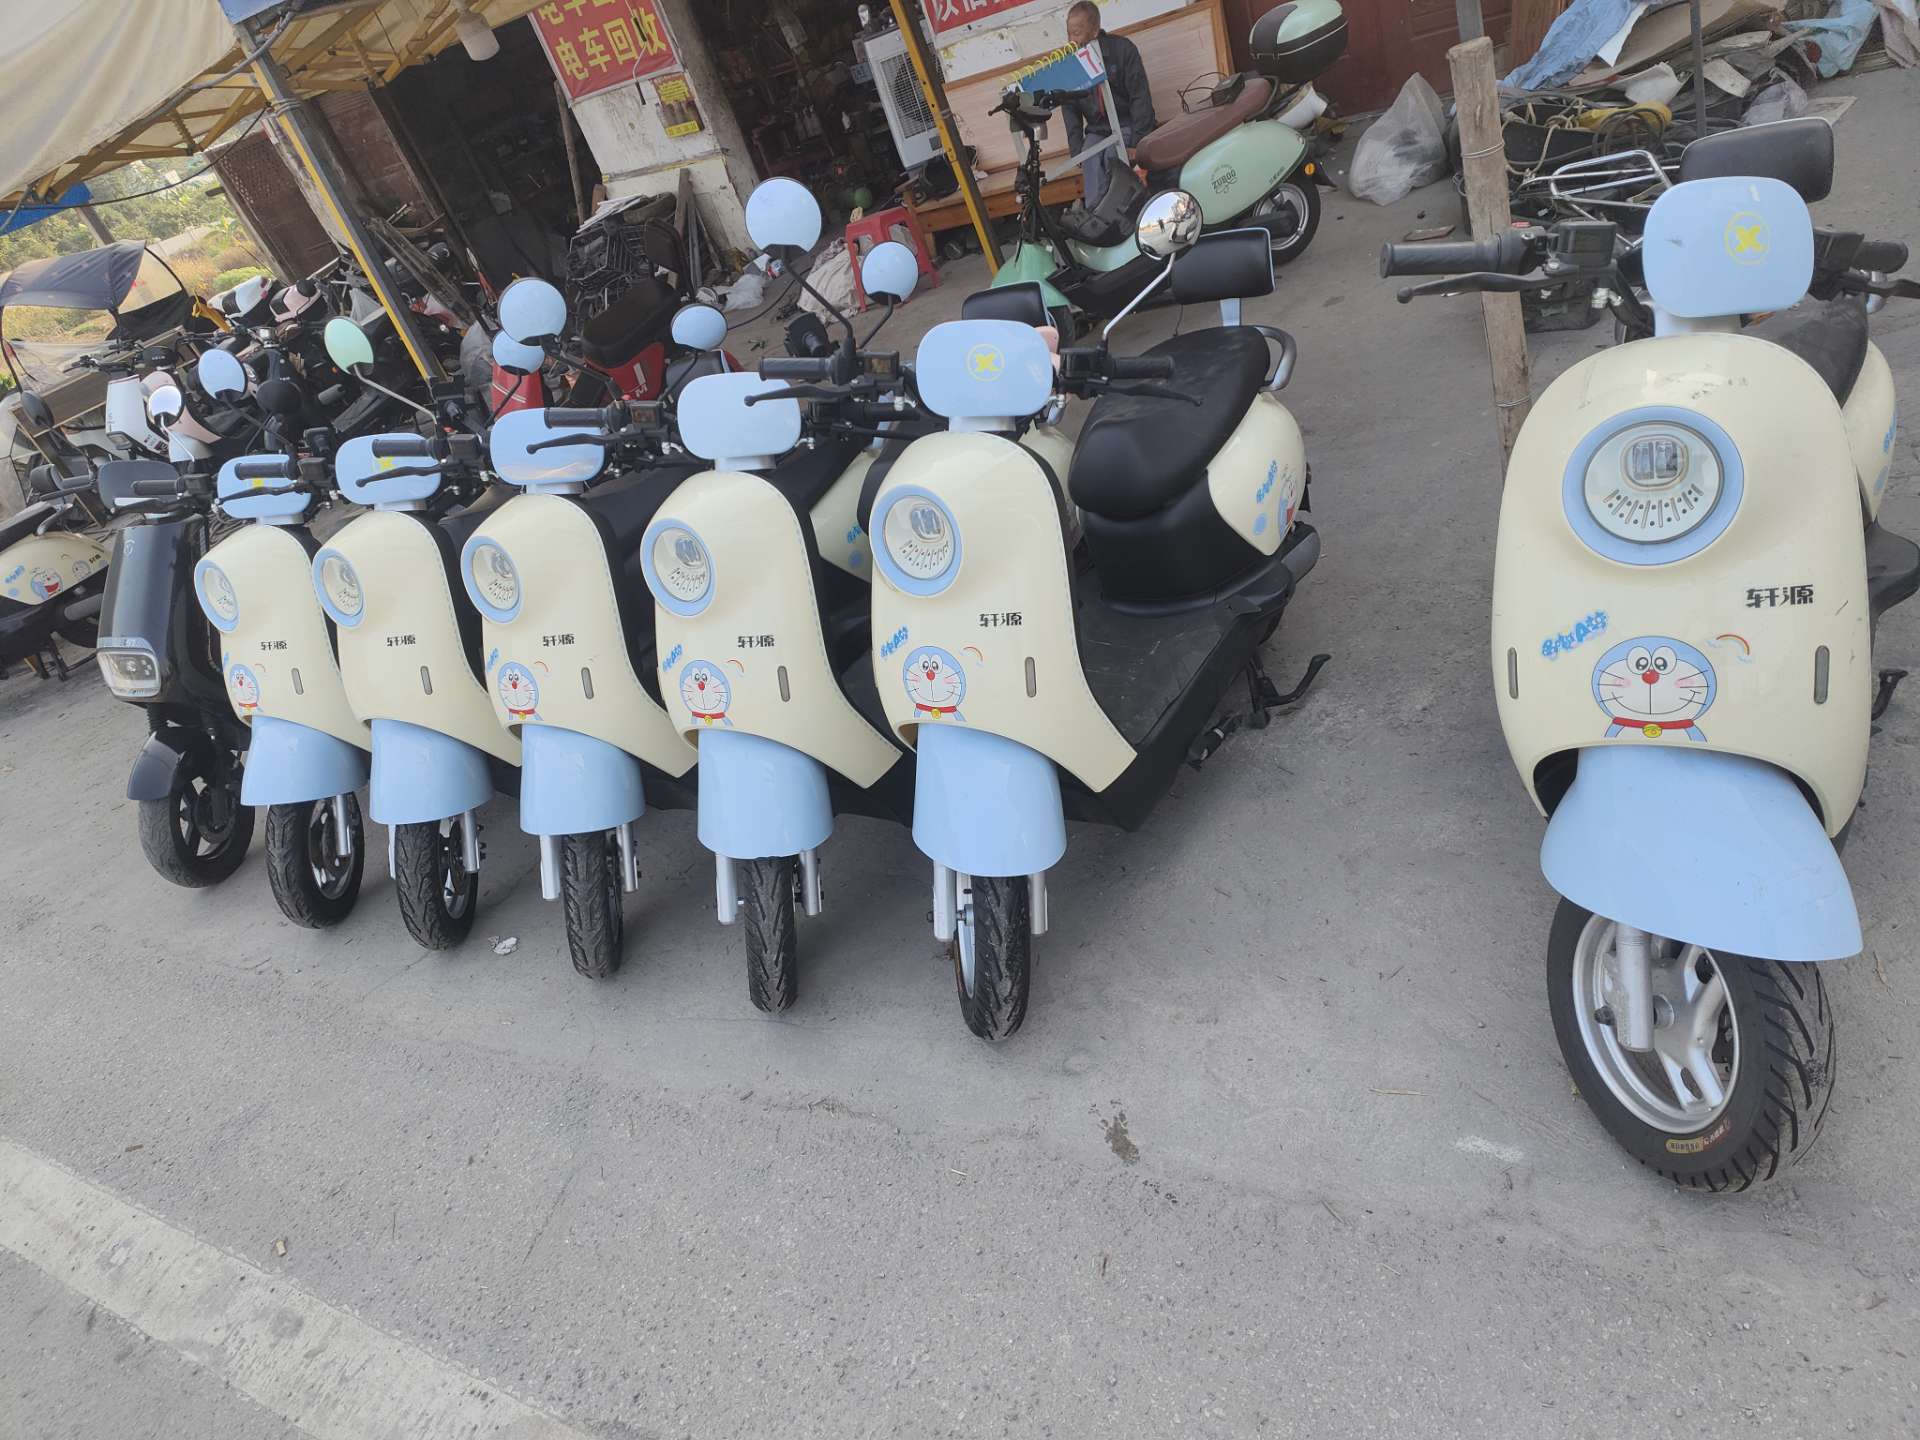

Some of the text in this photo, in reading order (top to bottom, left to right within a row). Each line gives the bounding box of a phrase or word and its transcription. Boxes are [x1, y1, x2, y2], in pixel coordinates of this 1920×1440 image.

[555, 8, 666, 80] 电车回收
[1746, 584, 1813, 608] 轩源
[980, 612, 1022, 627] 轩源
[738, 635, 774, 648] 轩源
